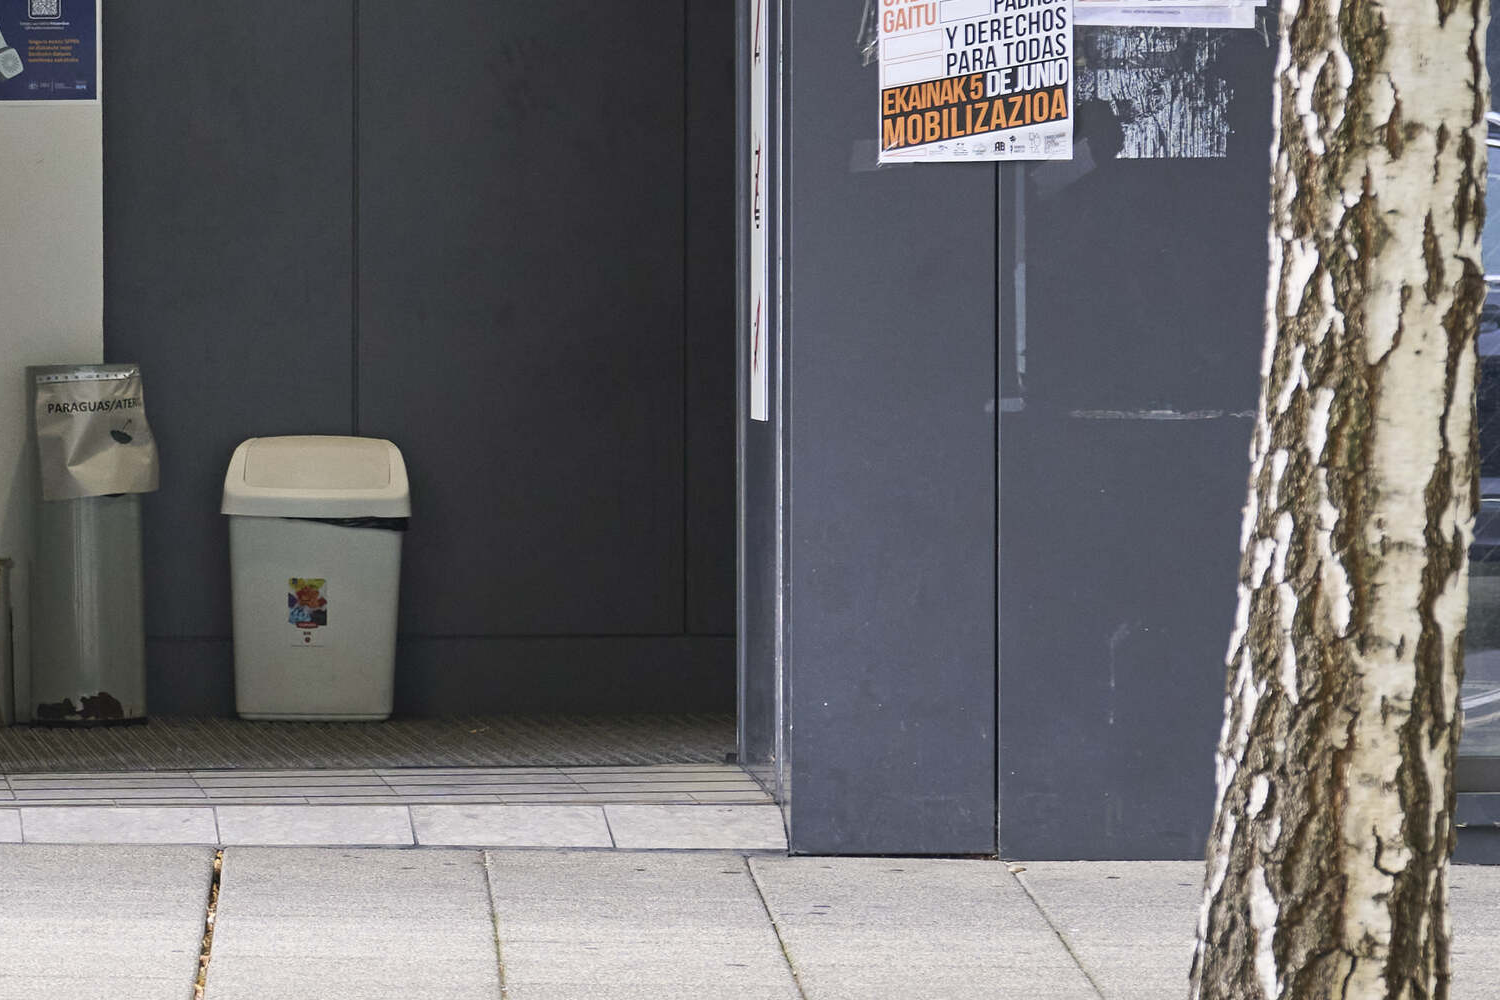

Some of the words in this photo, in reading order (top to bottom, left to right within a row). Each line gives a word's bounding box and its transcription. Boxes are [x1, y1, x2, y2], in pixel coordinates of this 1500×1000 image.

[883, 2, 936, 33] GAITU
[945, 26, 957, 49] Y
[964, 6, 1066, 46] DERECHOS
[947, 44, 997, 76] PARA
[1003, 33, 1066, 67] TODAS
[883, 76, 967, 116] EKAINAK
[970, 73, 984, 100] 5
[986, 68, 1013, 98] DE
[1013, 58, 1068, 93] JUNIO
[883, 88, 1068, 150] MOBILIZAZIOA
